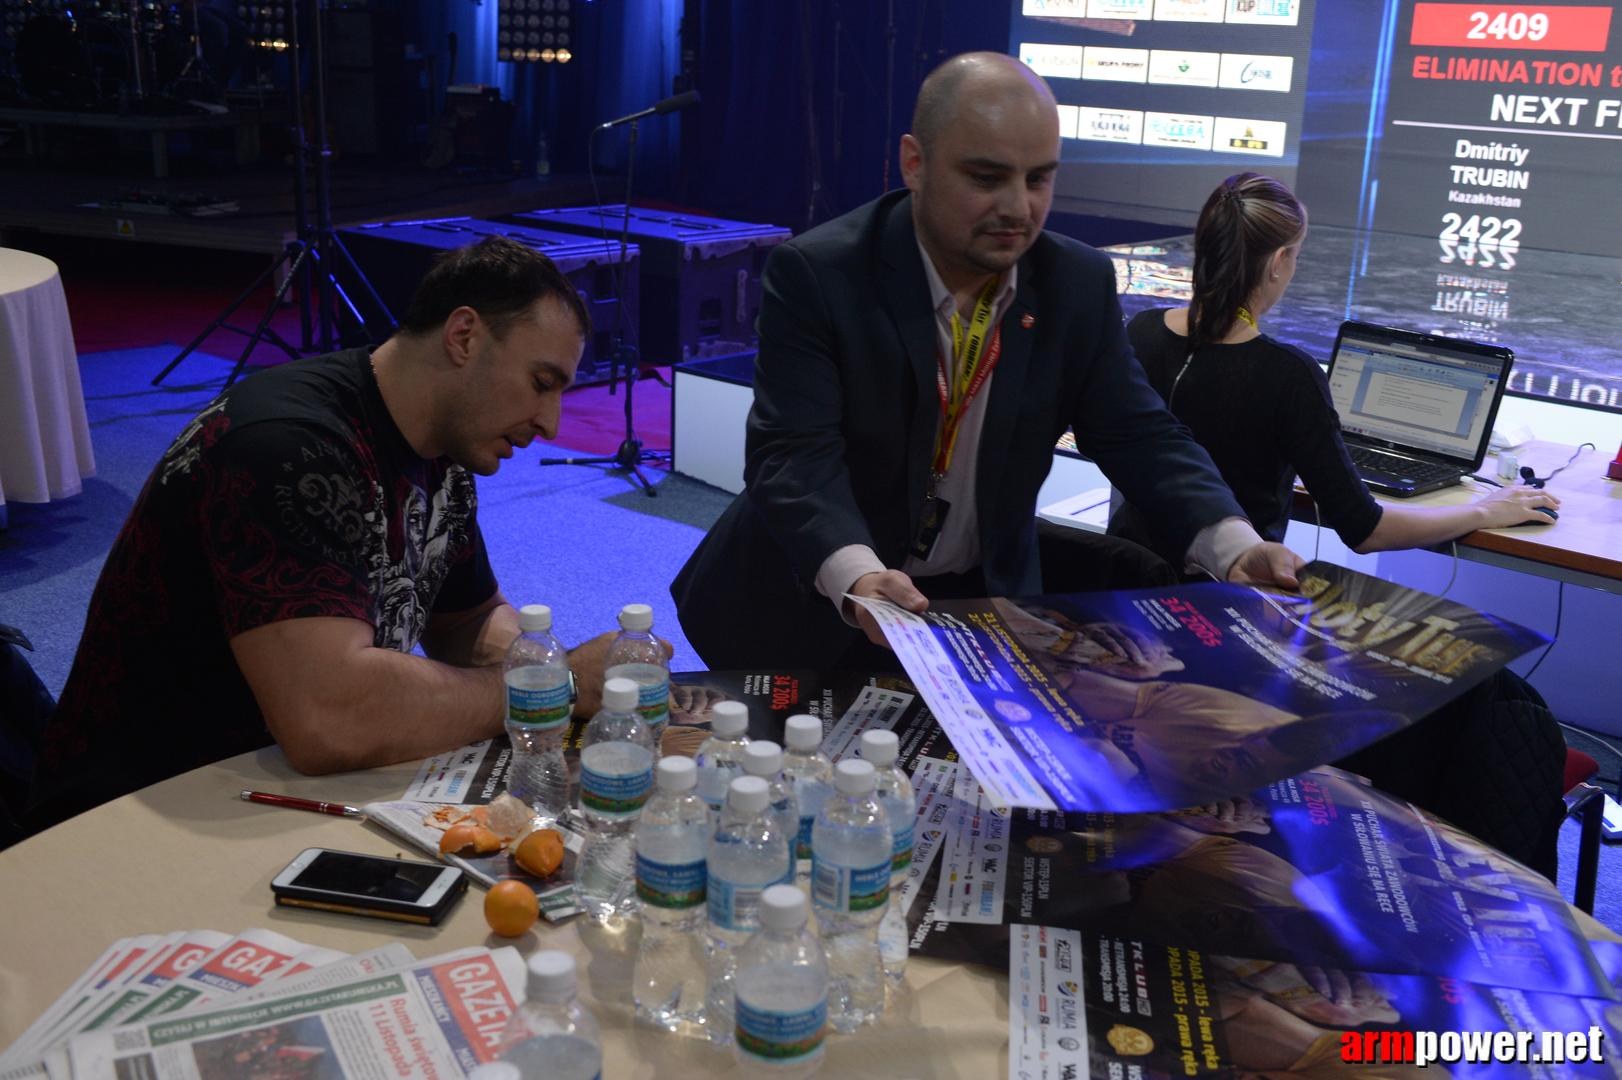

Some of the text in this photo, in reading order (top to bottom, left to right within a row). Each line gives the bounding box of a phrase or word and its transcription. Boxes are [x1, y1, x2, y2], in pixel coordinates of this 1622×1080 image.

[1466, 11, 1549, 41] 2409
[1412, 55, 1603, 87] ELIMINATION
[1490, 94, 1588, 126] NEXT
[1455, 139, 1529, 167] Dmitriy
[1450, 165, 1530, 190] TRUBIN
[1448, 190, 1521, 208] Kazakhstan
[1440, 212, 1522, 247] 2422
[769, 688, 790, 710] 200$
[1371, 880, 1385, 891] NA
[1385, 870, 1419, 933] ZAWODOWCÓW
[1172, 980, 1188, 1005] 2015
[1192, 981, 1209, 1007] 2015
[390, 998, 418, 1036] Rumia
[1062, 998, 1078, 1029] RUMIA
[369, 1004, 412, 1078] 11 Listopada
[1173, 1014, 1192, 1047] prawa
[1198, 1016, 1213, 1042] lewa
[1180, 1049, 1199, 1076] ręka
[1201, 1043, 1220, 1070] ręka
